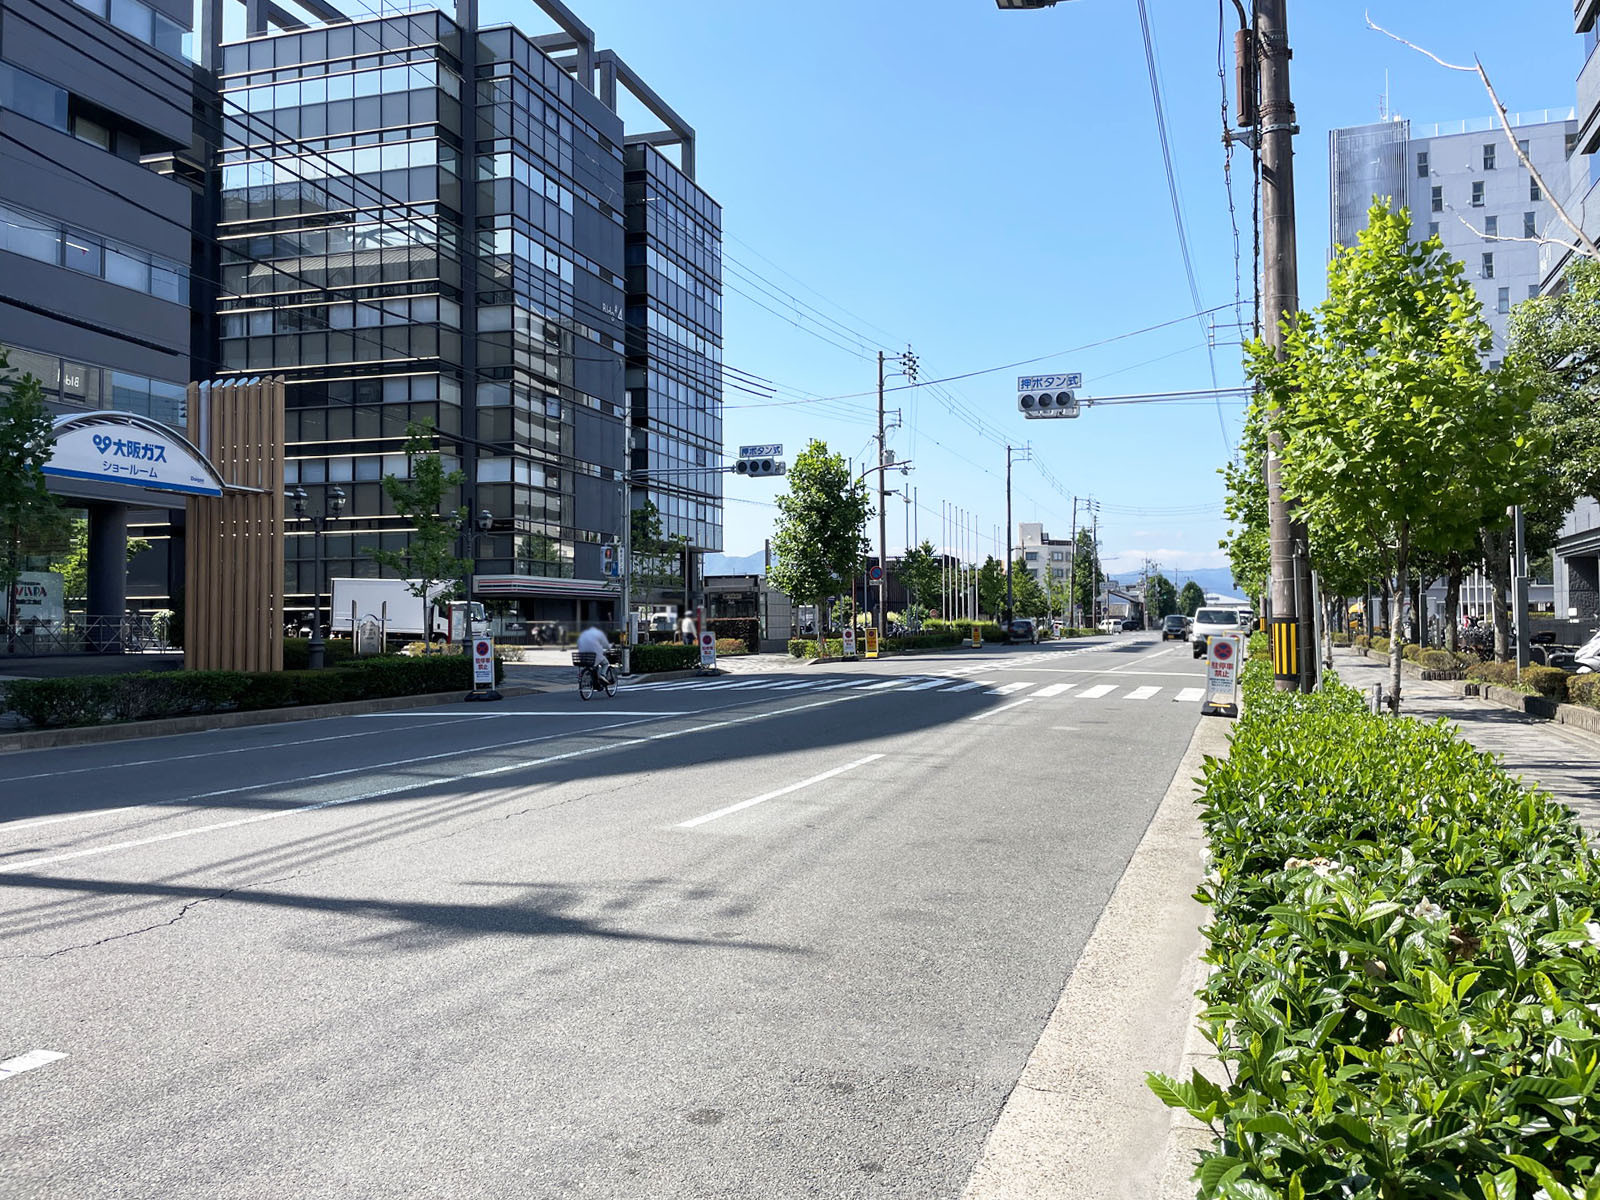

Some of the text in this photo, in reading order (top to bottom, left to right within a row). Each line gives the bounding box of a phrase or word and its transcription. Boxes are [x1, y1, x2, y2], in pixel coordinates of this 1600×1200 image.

[1020, 375, 1079, 389] 押ボタン式
[113, 439, 167, 463] 大阪ガス
[103, 460, 158, 478] ショールーム
